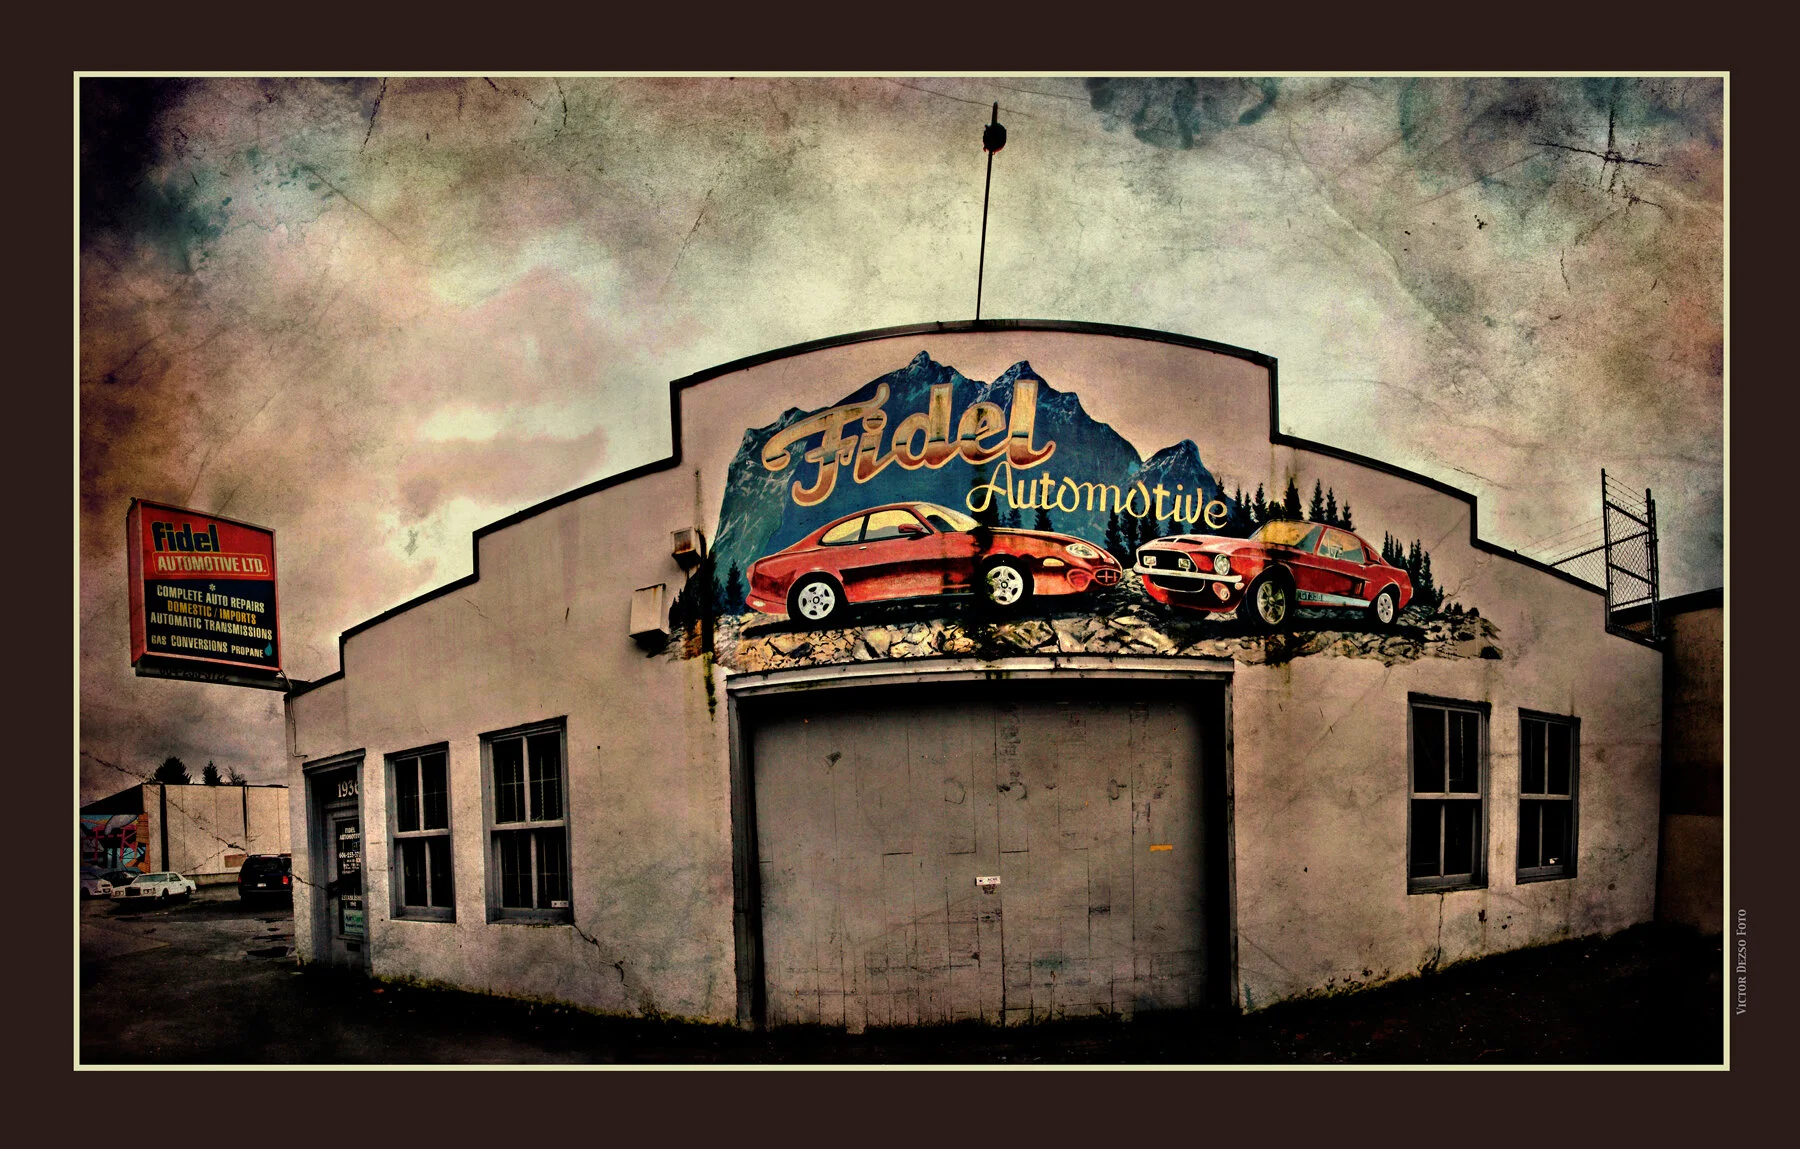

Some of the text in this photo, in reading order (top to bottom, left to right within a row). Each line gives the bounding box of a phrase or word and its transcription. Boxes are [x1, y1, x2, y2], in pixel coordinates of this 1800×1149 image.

[762, 379, 1056, 507] Fidel
[966, 461, 1228, 529] Automotive
[157, 555, 267, 573] AUTOMOTIVE LTD.
[156, 584, 265, 614] COMPLETE AUTO REPAIRS
[167, 600, 212, 618] DOMESTIC
[219, 608, 257, 625] IMPORTS
[150, 612, 273, 641] AUTOMATIC TRANSMISSIONS
[151, 634, 264, 659] GAS CONVERSIONS PROPANE
